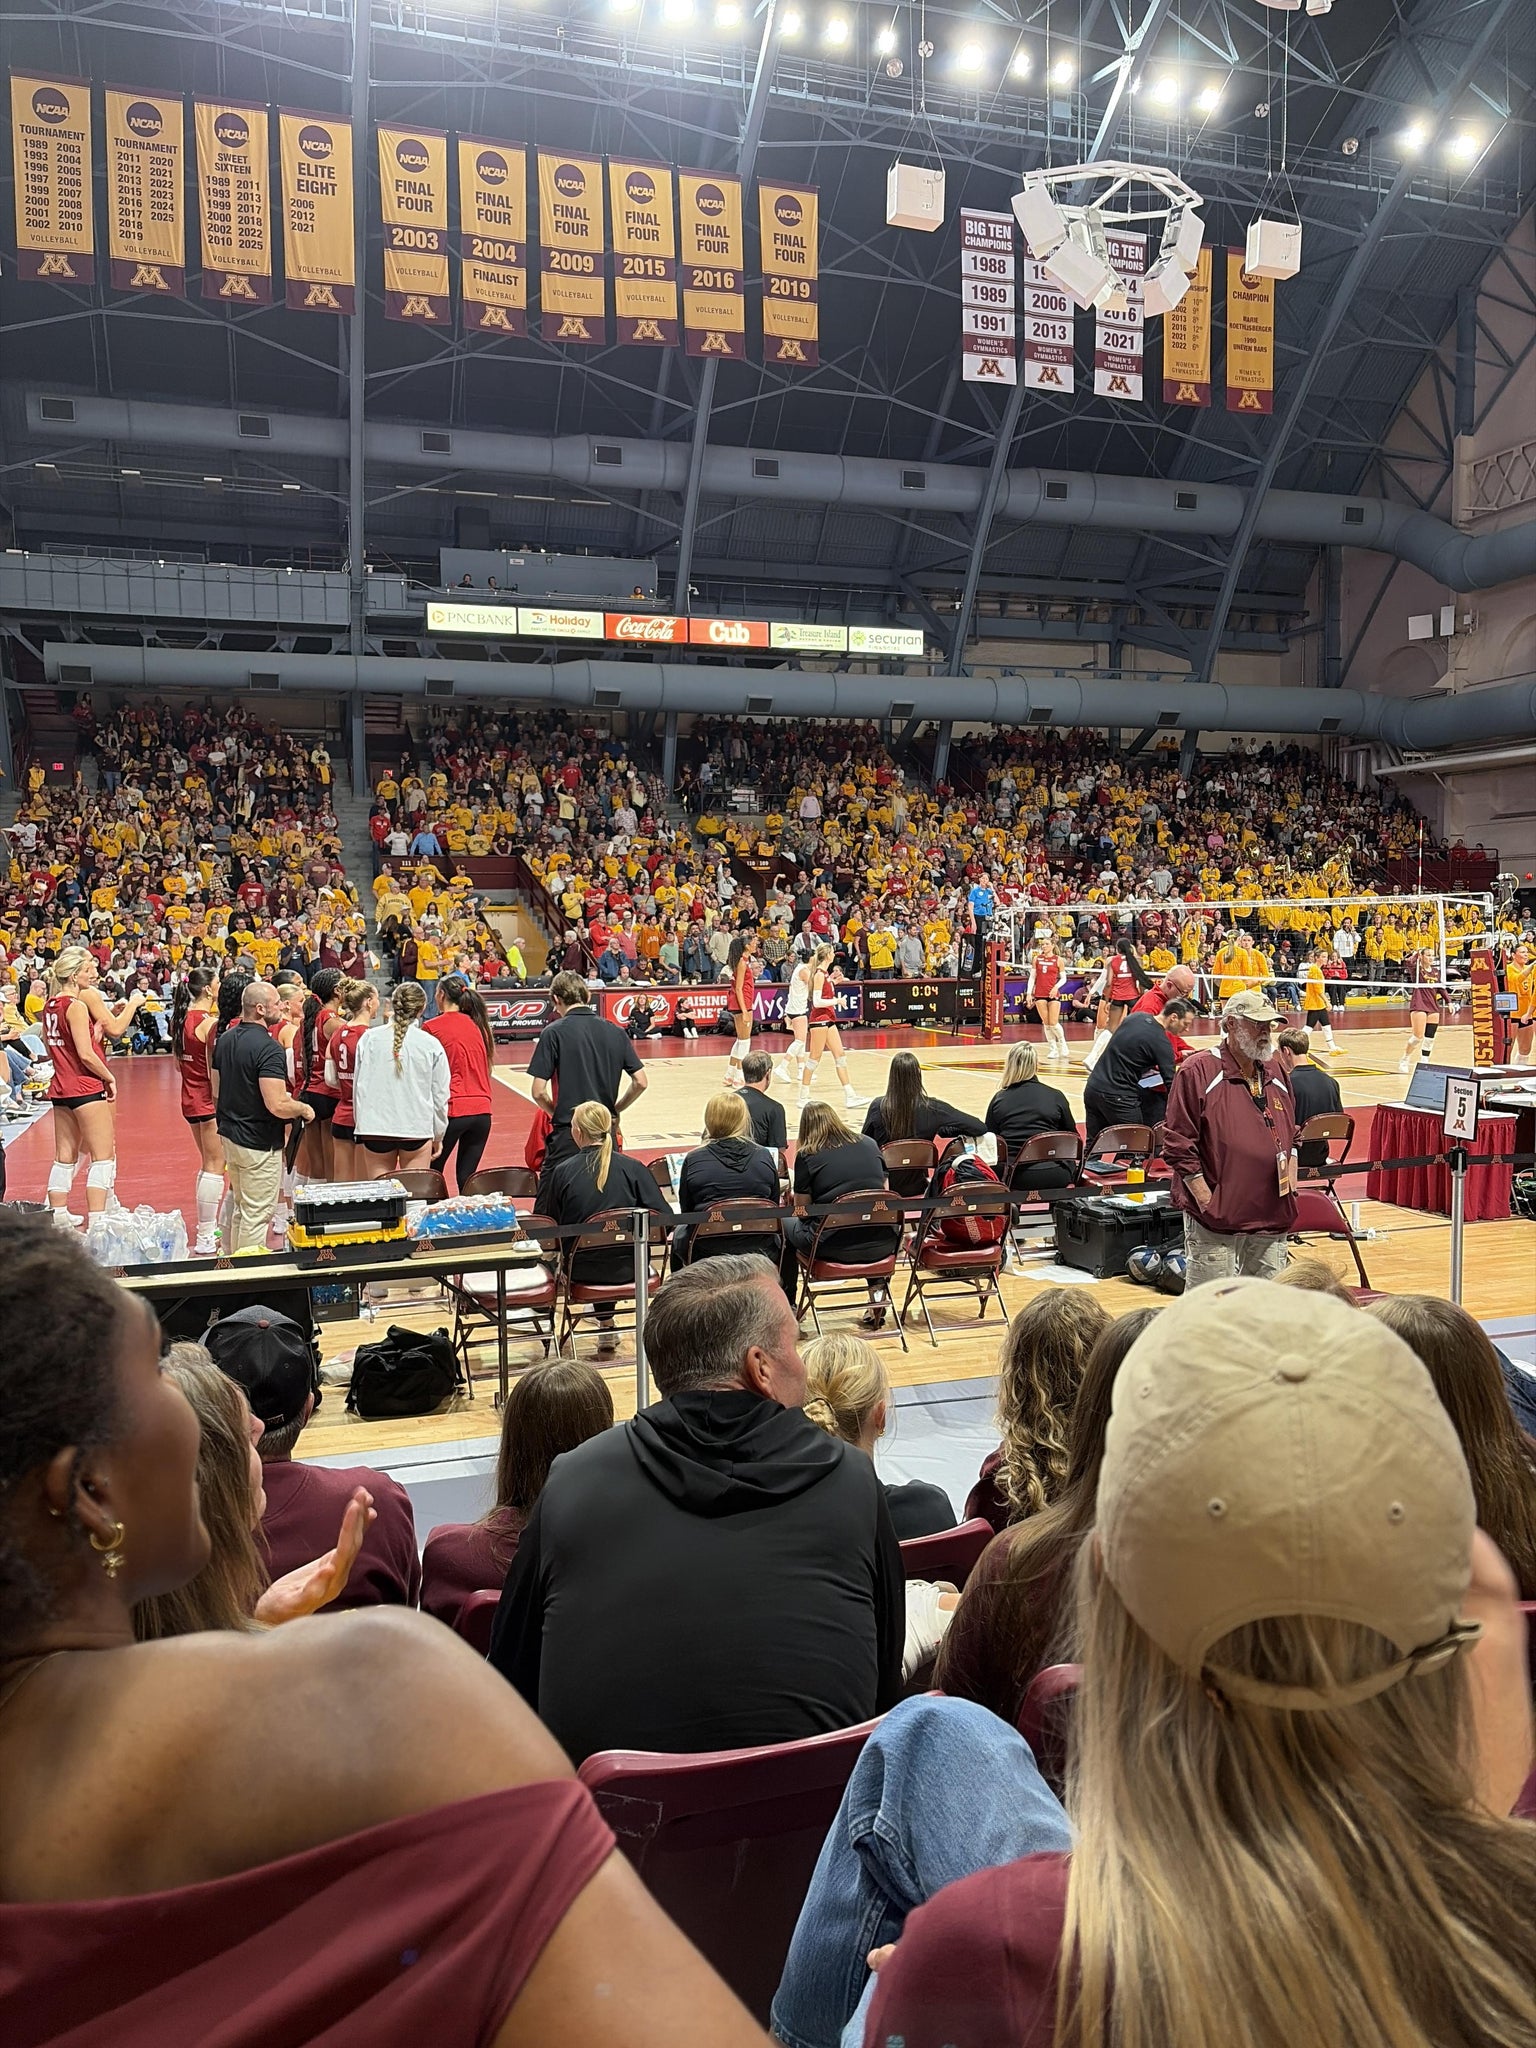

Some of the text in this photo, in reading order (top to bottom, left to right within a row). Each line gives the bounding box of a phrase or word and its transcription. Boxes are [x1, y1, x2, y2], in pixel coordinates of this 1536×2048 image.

[35, 103, 69, 116] NCAA
[129, 117, 162, 130] NCAA
[19, 124, 85, 141] TOURNAMENT
[218, 128, 248, 141] NCAA
[24, 139, 81, 153] 1989 2003
[114, 138, 178, 154] TOURNAMENT
[302, 139, 332, 152] NCAA
[24, 151, 81, 164] 1993 2004
[117, 152, 173, 167] 2011 2020
[218, 153, 248, 164] SWEET
[400, 154, 428, 165] NCAA
[24, 162, 81, 176] 1996 2005
[118, 163, 172, 178] 2012 2021
[215, 162, 251, 174] SIXTEEN
[298, 162, 336, 180] ELITE
[479, 165, 507, 177] NCAA
[24, 173, 82, 187] 1997 2006
[118, 174, 174, 189] 2013 2022
[206, 175, 260, 190] 1989 2011
[557, 178, 584, 190] NCAA
[25, 185, 82, 198] 1999 2007
[118, 186, 174, 200] 2015 2023
[297, 179, 337, 197] EIGHT
[395, 179, 434, 196] FINAL
[629, 186, 655, 197] NCAA
[206, 188, 261, 202] 1993 2013
[475, 191, 512, 209] FINAL
[25, 196, 82, 210] 2000 2008
[118, 197, 174, 211] 2016 2024
[207, 200, 261, 214] 1999 2017
[290, 198, 314, 209] 2006
[397, 196, 433, 212] FOUR
[699, 199, 725, 209] NCAA
[25, 207, 82, 221] 2001 2009
[118, 208, 174, 222] 2017 2025
[207, 212, 262, 226] 2000 2018
[291, 210, 315, 221] 2012
[477, 208, 511, 225] FOUR
[553, 204, 590, 221] FINAL
[626, 211, 660, 226] FINAL
[777, 209, 802, 220] NCAA
[25, 218, 83, 232] 2002 2010
[119, 219, 143, 229] 2018
[207, 223, 262, 238] 2002 2022
[291, 222, 314, 232] 2021
[555, 220, 589, 236] FOUR
[695, 224, 730, 238] FINAL
[966, 220, 1011, 239] BIG TEN
[30, 234, 78, 245] VOLLEYBALL
[119, 230, 143, 241] 2019
[392, 228, 438, 250] 2003
[627, 227, 659, 241] FOUR
[774, 233, 807, 248] FINAL
[208, 235, 263, 250] 2010 2025
[697, 239, 729, 254] FOUR
[965, 236, 1012, 251] CHAMPIONS
[124, 245, 171, 257] VOLLEYBALL
[472, 239, 516, 262] 2004
[775, 248, 805, 264] FOUR
[1108, 242, 1143, 260] IG TEN
[212, 255, 260, 267] VOLLEYBALL
[550, 251, 594, 272] 2009
[623, 258, 665, 276] 2015
[971, 256, 1006, 274] 1988
[1110, 258, 1143, 271] AMPIONS
[298, 265, 342, 276] VOLLEYBALL
[396, 267, 438, 278] VOLLEYBALL
[473, 268, 518, 286] FINALIST
[693, 270, 735, 289] 2016
[476, 288, 516, 301] VOLLEYBALL
[553, 289, 592, 299] VOLLEYBALL
[770, 278, 810, 298] 2019
[972, 285, 1006, 303] 1989
[627, 295, 666, 303] VOLLEYBALL
[1033, 294, 1066, 311] 2006
[1233, 291, 1269, 302] CHAMPION
[696, 307, 734, 315] VOLLEYBALL
[1172, 314, 1186, 322] 2013
[773, 314, 809, 324] VOLLEYBALL
[972, 314, 1006, 331] 1991
[1033, 322, 1066, 340] 2013
[1172, 323, 1186, 331] 2016
[977, 338, 1003, 346] WOMEN'S
[1104, 332, 1134, 349] 2021
[973, 345, 1008, 354] GYMNASTICS
[1038, 346, 1062, 354] WOMEN'S
[1034, 353, 1067, 362] GYMNASTICS
[1108, 355, 1131, 364] WOMEN'S
[1104, 362, 1136, 372] GYMNASTICS
[550, 615, 591, 628] Holiday
[709, 621, 750, 644] Cub
[800, 628, 841, 638] Treasure Island
[869, 634, 922, 645] securian
[1042, 966, 1048, 974] 5
[1119, 961, 1128, 973] 4
[912, 985, 939, 997] 0:04
[876, 998, 974, 1011] 15 14
[929, 1003, 937, 1012] 4
[46, 1013, 60, 1036] 12
[339, 1043, 348, 1069] 3
[1454, 1086, 1473, 1096] Section
[1458, 1096, 1466, 1117] 5
